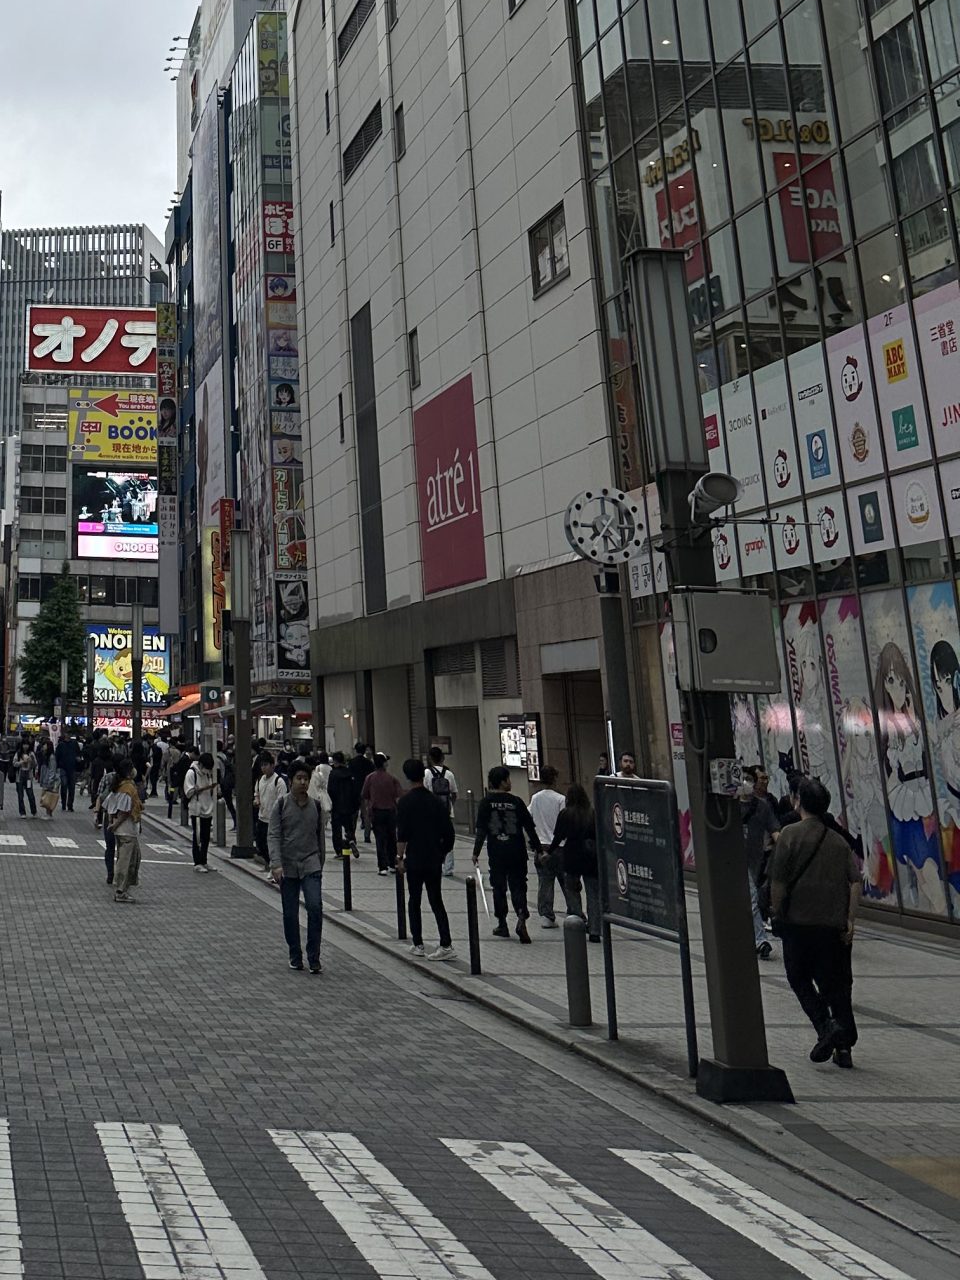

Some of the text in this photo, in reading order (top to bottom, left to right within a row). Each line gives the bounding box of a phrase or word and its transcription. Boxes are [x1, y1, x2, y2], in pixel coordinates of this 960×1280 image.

[267, 239, 282, 251] 6F
[884, 313, 893, 328] 2F
[929, 320, 956, 342] 三省堂
[940, 337, 958, 357] 書店
[885, 345, 904, 366] ABC
[887, 363, 907, 380] MART
[732, 381, 740, 394] 3F
[129, 393, 154, 405] 現在地
[82, 422, 100, 433] ここ!
[728, 414, 752, 432] 3COINS
[112, 443, 157, 454] 現在地から
[427, 448, 478, 526] atré 1
[90, 633, 165, 651] ONOEN
[117, 708, 131, 717] TAX
